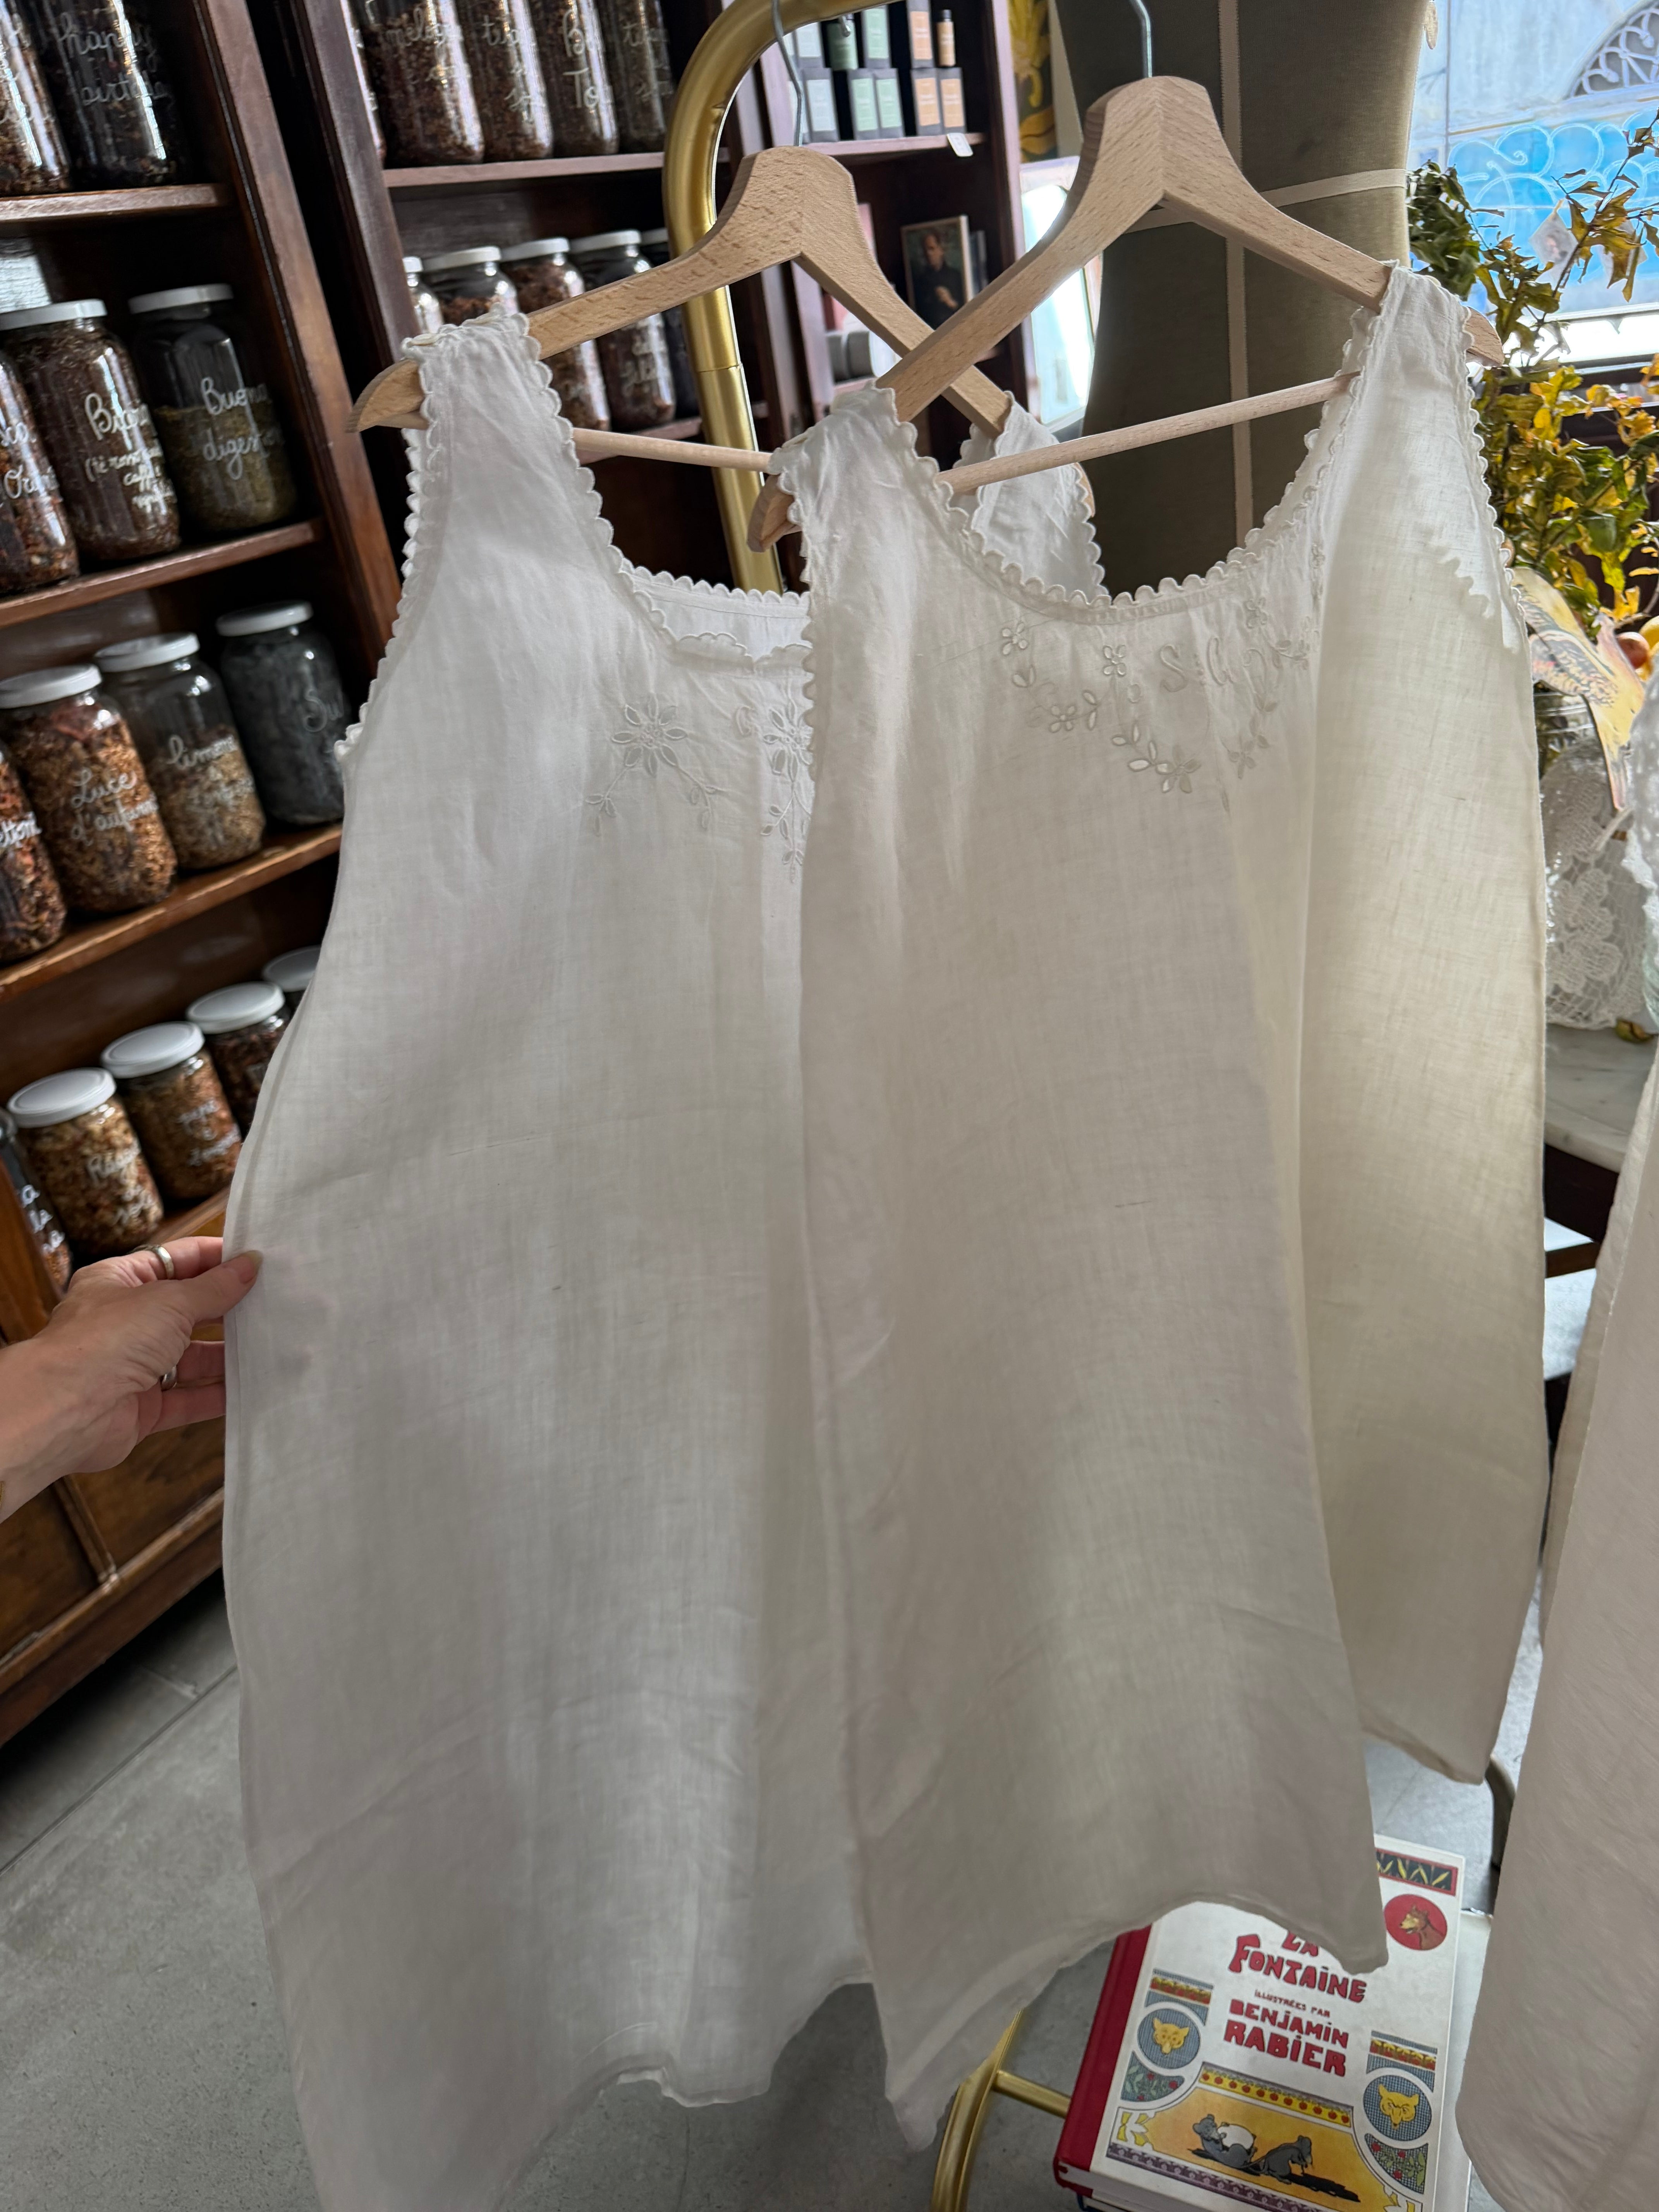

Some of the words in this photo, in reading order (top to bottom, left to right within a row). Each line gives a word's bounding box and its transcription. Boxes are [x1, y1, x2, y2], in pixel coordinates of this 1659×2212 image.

[1228, 1933, 1367, 2003] FONTAINE
[1229, 1998, 1350, 2049] BENJAMIN
[1310, 2006, 1331, 2018] PAR
[1223, 2018, 1346, 2077] RABIER
